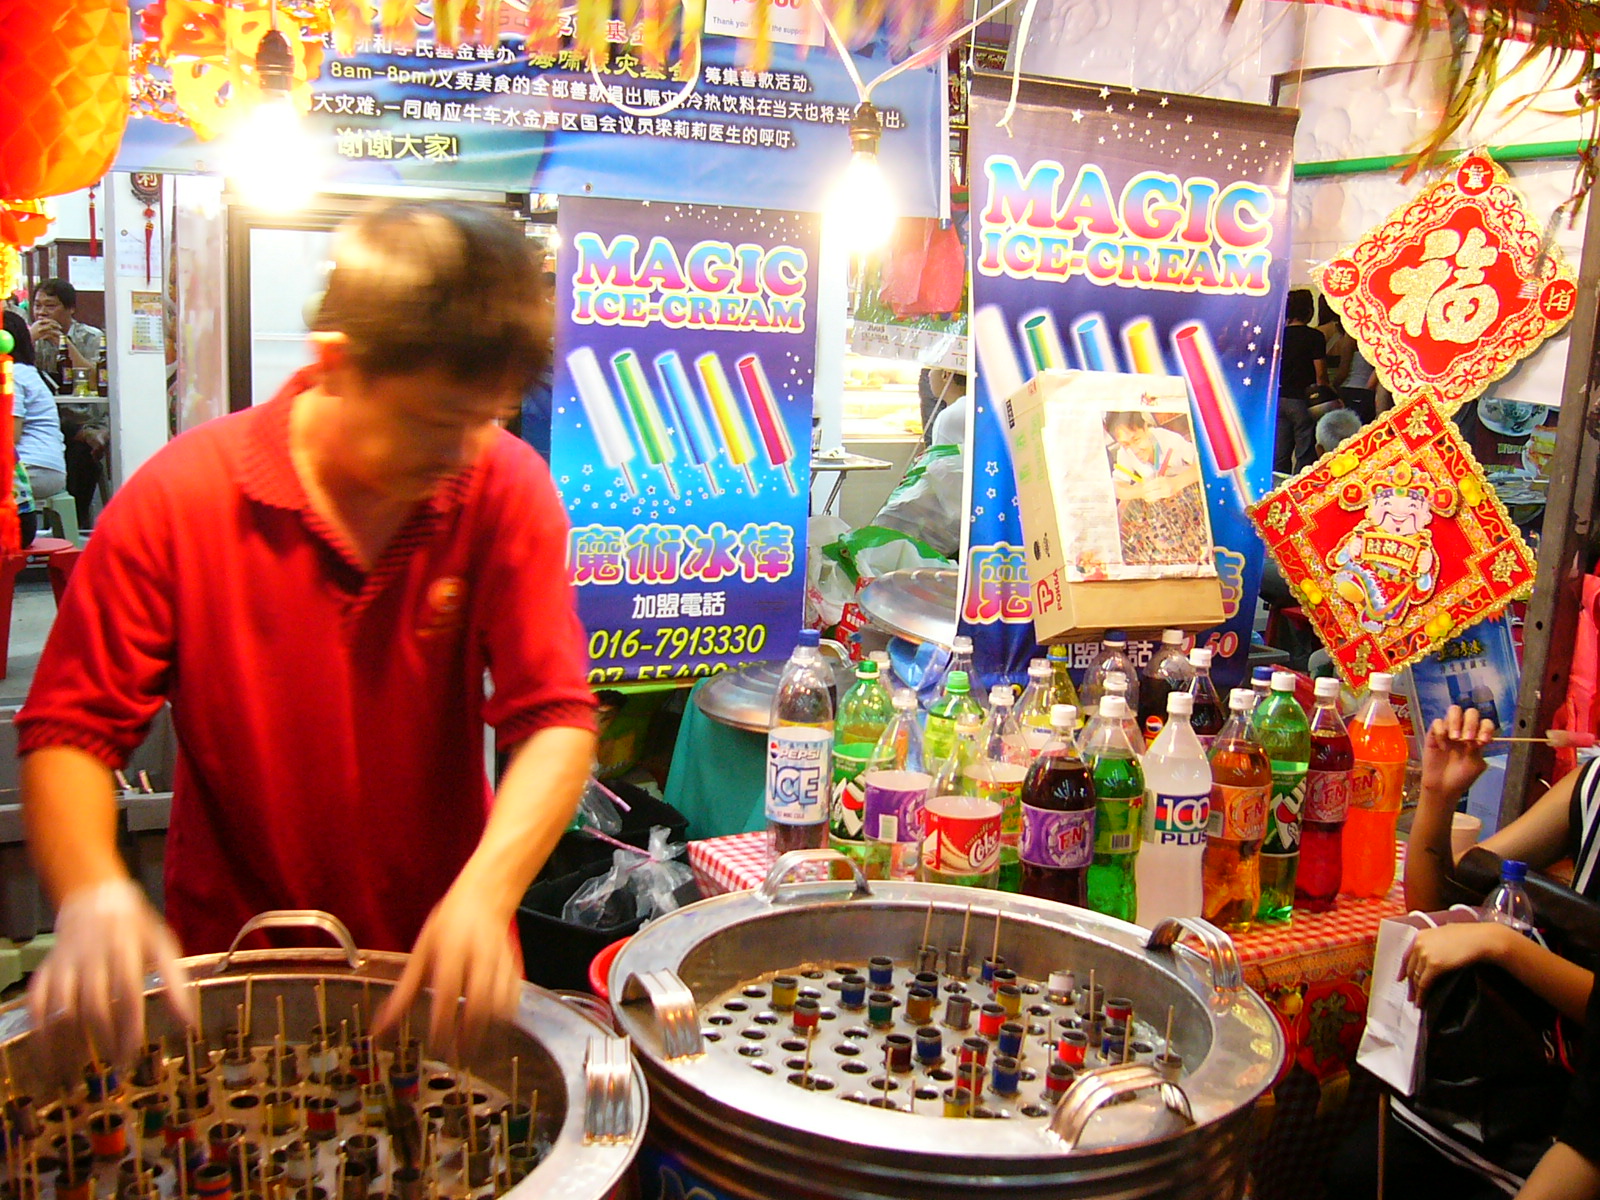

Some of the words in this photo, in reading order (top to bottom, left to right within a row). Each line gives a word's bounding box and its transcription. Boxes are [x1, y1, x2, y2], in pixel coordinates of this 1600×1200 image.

[713, 16, 734, 27] Thank
[771, 25, 782, 33] the
[337, 127, 460, 162] 谢谢大家!
[984, 155, 1273, 252] MAGIC
[574, 232, 808, 297] MAGIC
[978, 231, 1271, 296] ICE-CREAM
[1388, 227, 1500, 345] 福
[572, 288, 804, 334] ICE-CREAM
[568, 522, 795, 585] 魔術冰棒
[632, 591, 727, 619] 加盟電話
[588, 624, 767, 660] 016-7913330
[780, 749, 820, 761] PEPSI
[770, 761, 820, 805] ICE
[1163, 797, 1210, 832] 100
[968, 830, 1001, 868] Coke
[1161, 832, 1208, 846] PLUS
